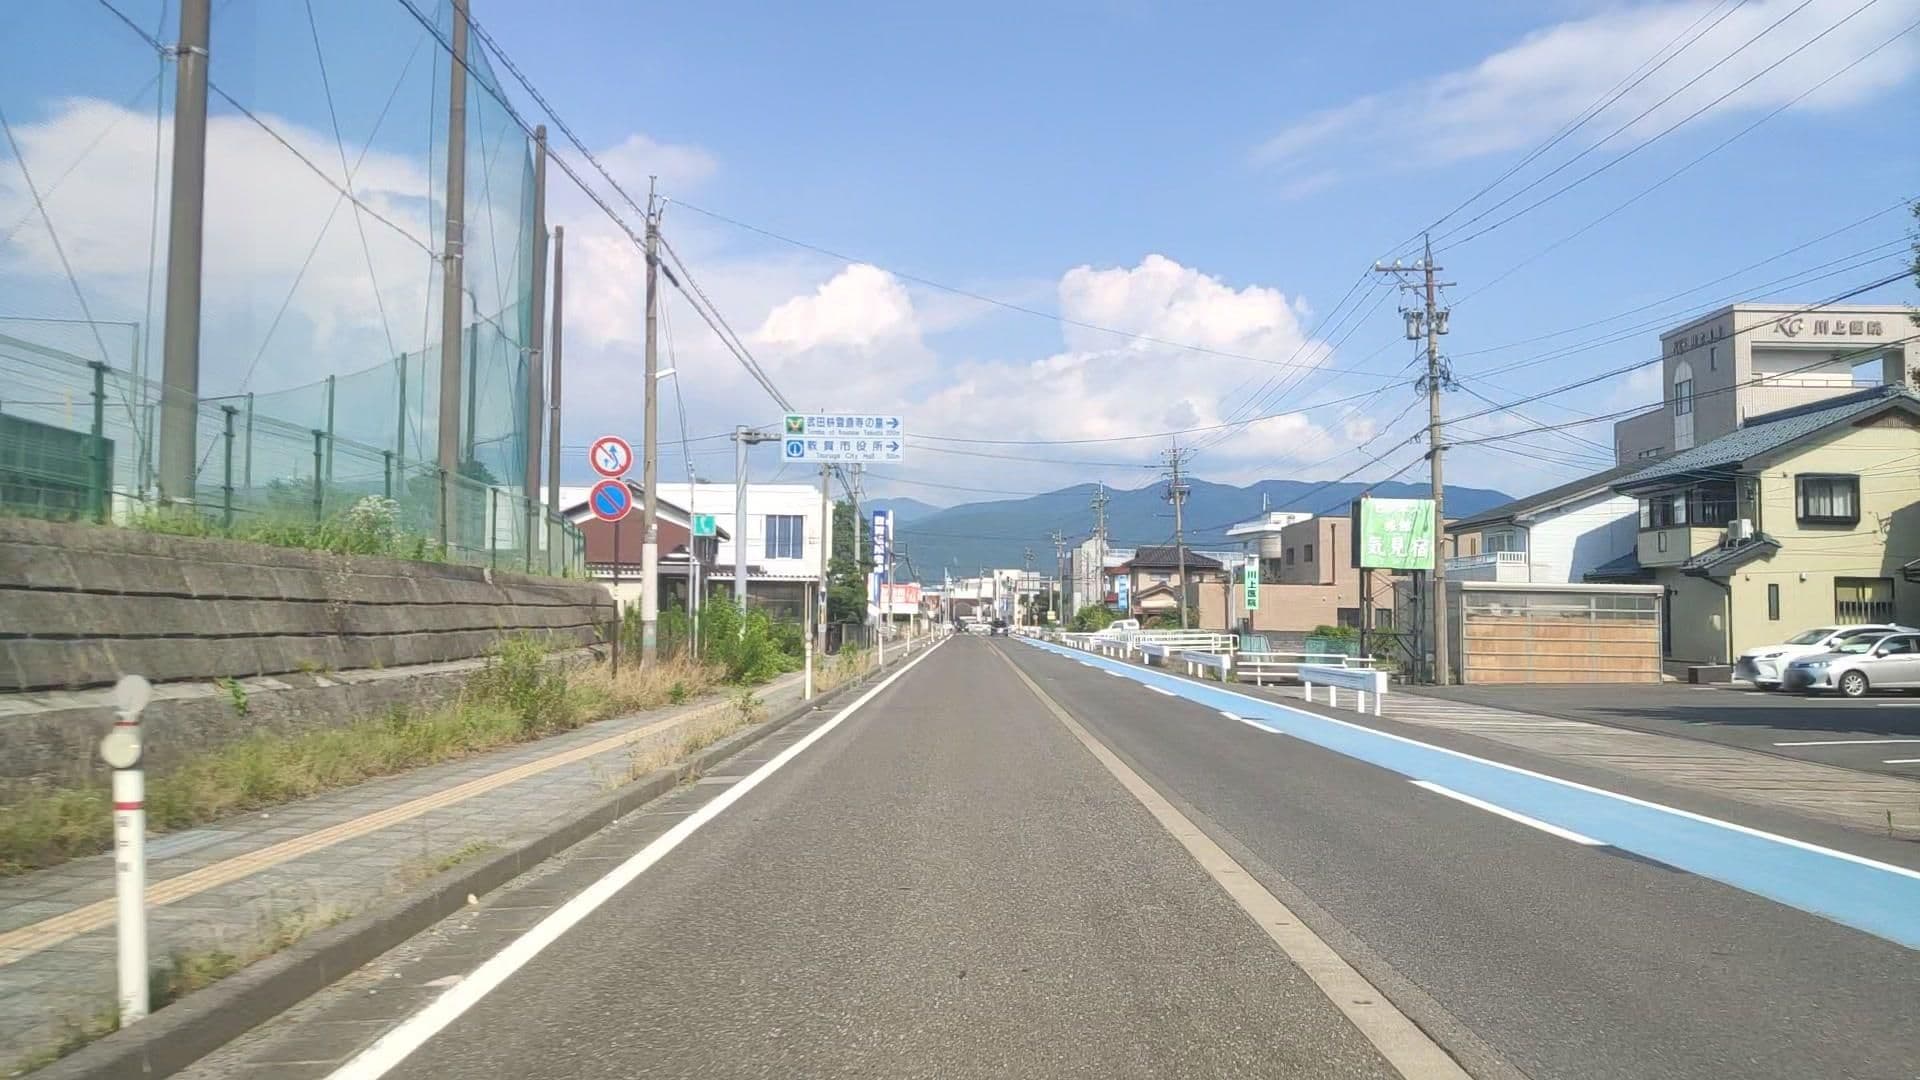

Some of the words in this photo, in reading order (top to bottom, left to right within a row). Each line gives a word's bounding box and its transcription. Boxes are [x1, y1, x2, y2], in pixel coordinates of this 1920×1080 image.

[1813, 319, 1884, 337] 川上医院
[807, 440, 883, 452] 敦賀市役所
[1247, 570, 1257, 607] 川上医院
